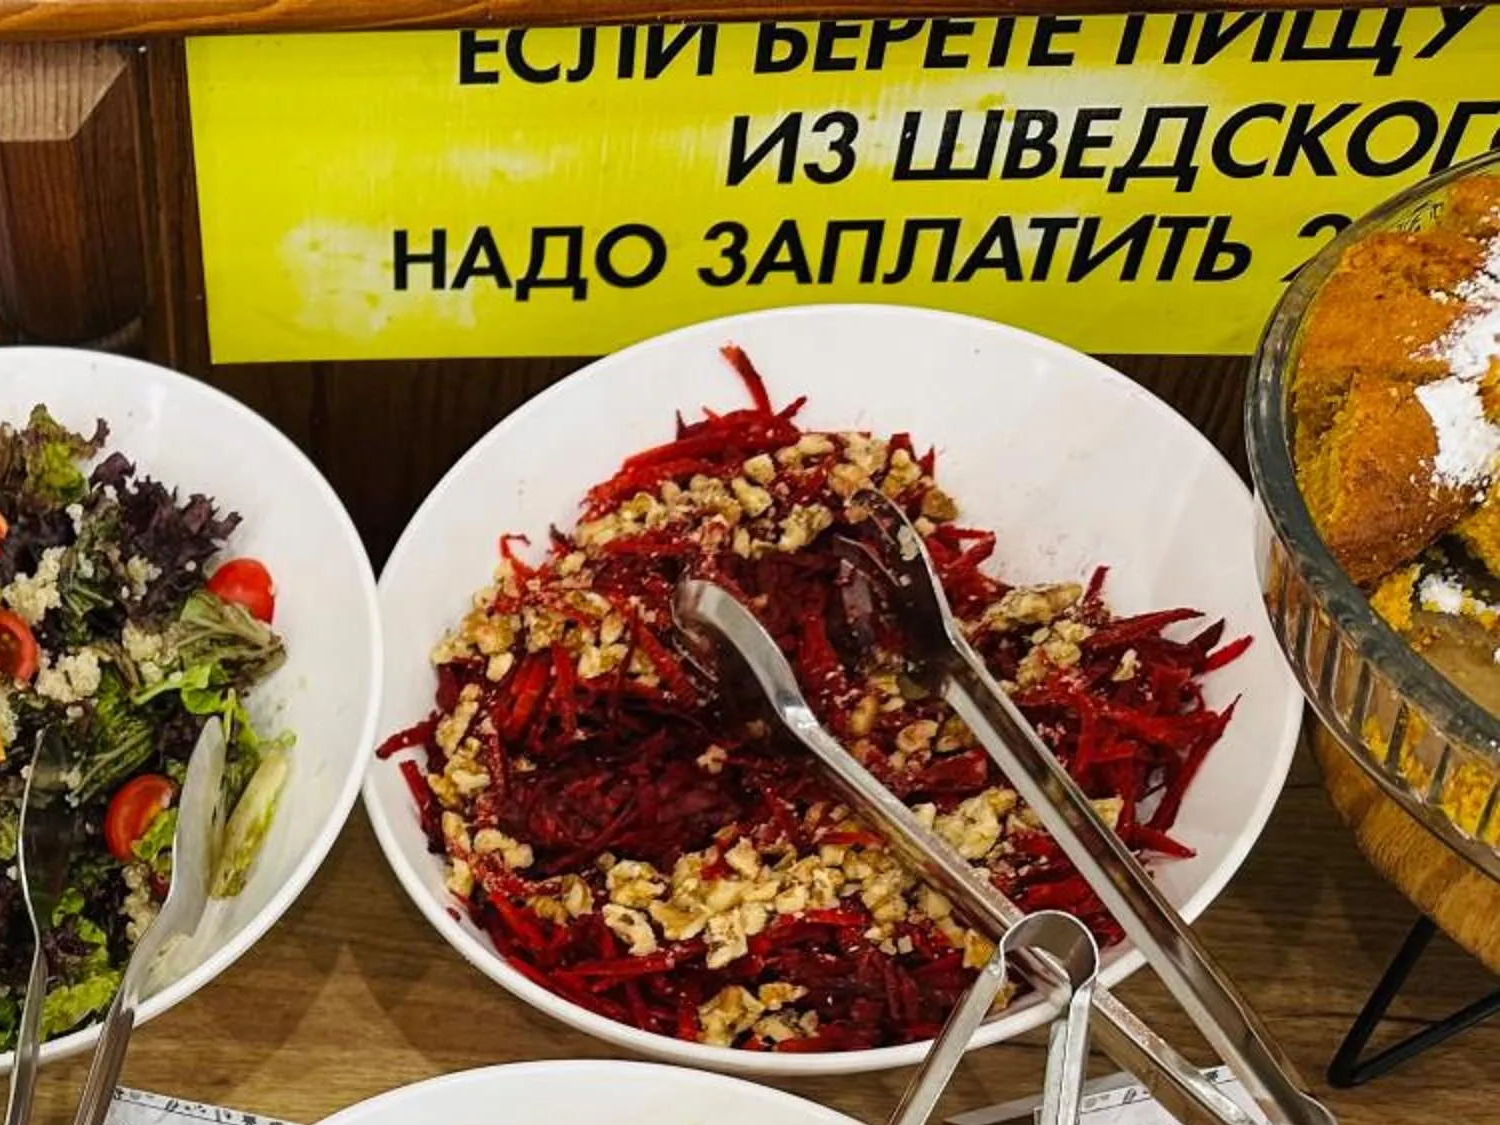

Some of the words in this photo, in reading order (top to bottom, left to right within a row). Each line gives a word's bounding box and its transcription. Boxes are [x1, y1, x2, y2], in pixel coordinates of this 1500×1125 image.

[458, 24, 718, 85] ЕСЛИ
[754, 17, 1082, 74] БЕРЕТЕ
[1115, 5, 1488, 77] ПИЩУ
[727, 112, 858, 186] ИЗ
[893, 101, 1500, 193] ШВЕДСКОГ
[394, 224, 666, 301] НАДО
[698, 214, 1252, 287] ЗАПЛАТИТЬ
